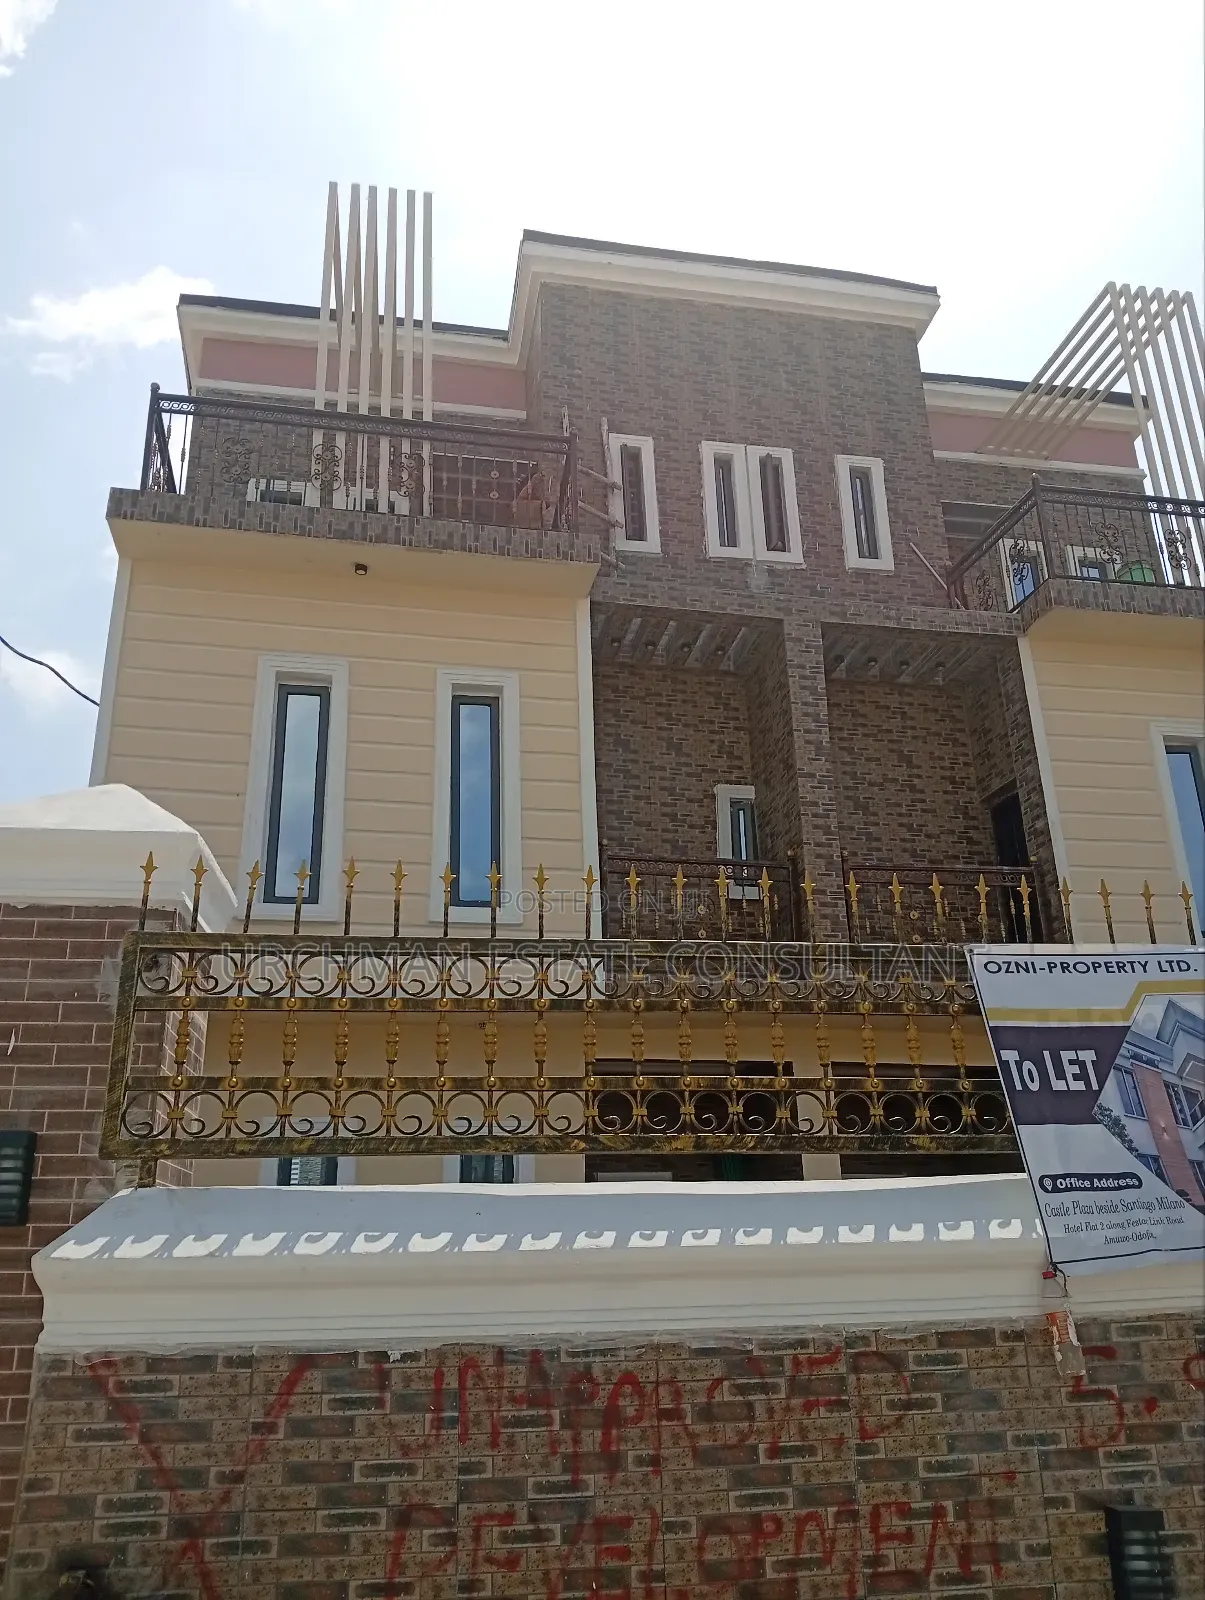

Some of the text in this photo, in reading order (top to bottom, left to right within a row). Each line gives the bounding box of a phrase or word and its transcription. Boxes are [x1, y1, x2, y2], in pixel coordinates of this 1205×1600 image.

[983, 959, 1198, 975] OZNI-PROPERTY LTD.
[1000, 1049, 1100, 1092] To LET
[1056, 1176, 1139, 1188] Office Address
[1093, 1199, 1121, 1215] beside
[1120, 1198, 1156, 1213] Santiago
[1155, 1196, 1186, 1210] Milano
[1063, 1222, 1084, 1234] Hotel
[1105, 1220, 1126, 1231] along
